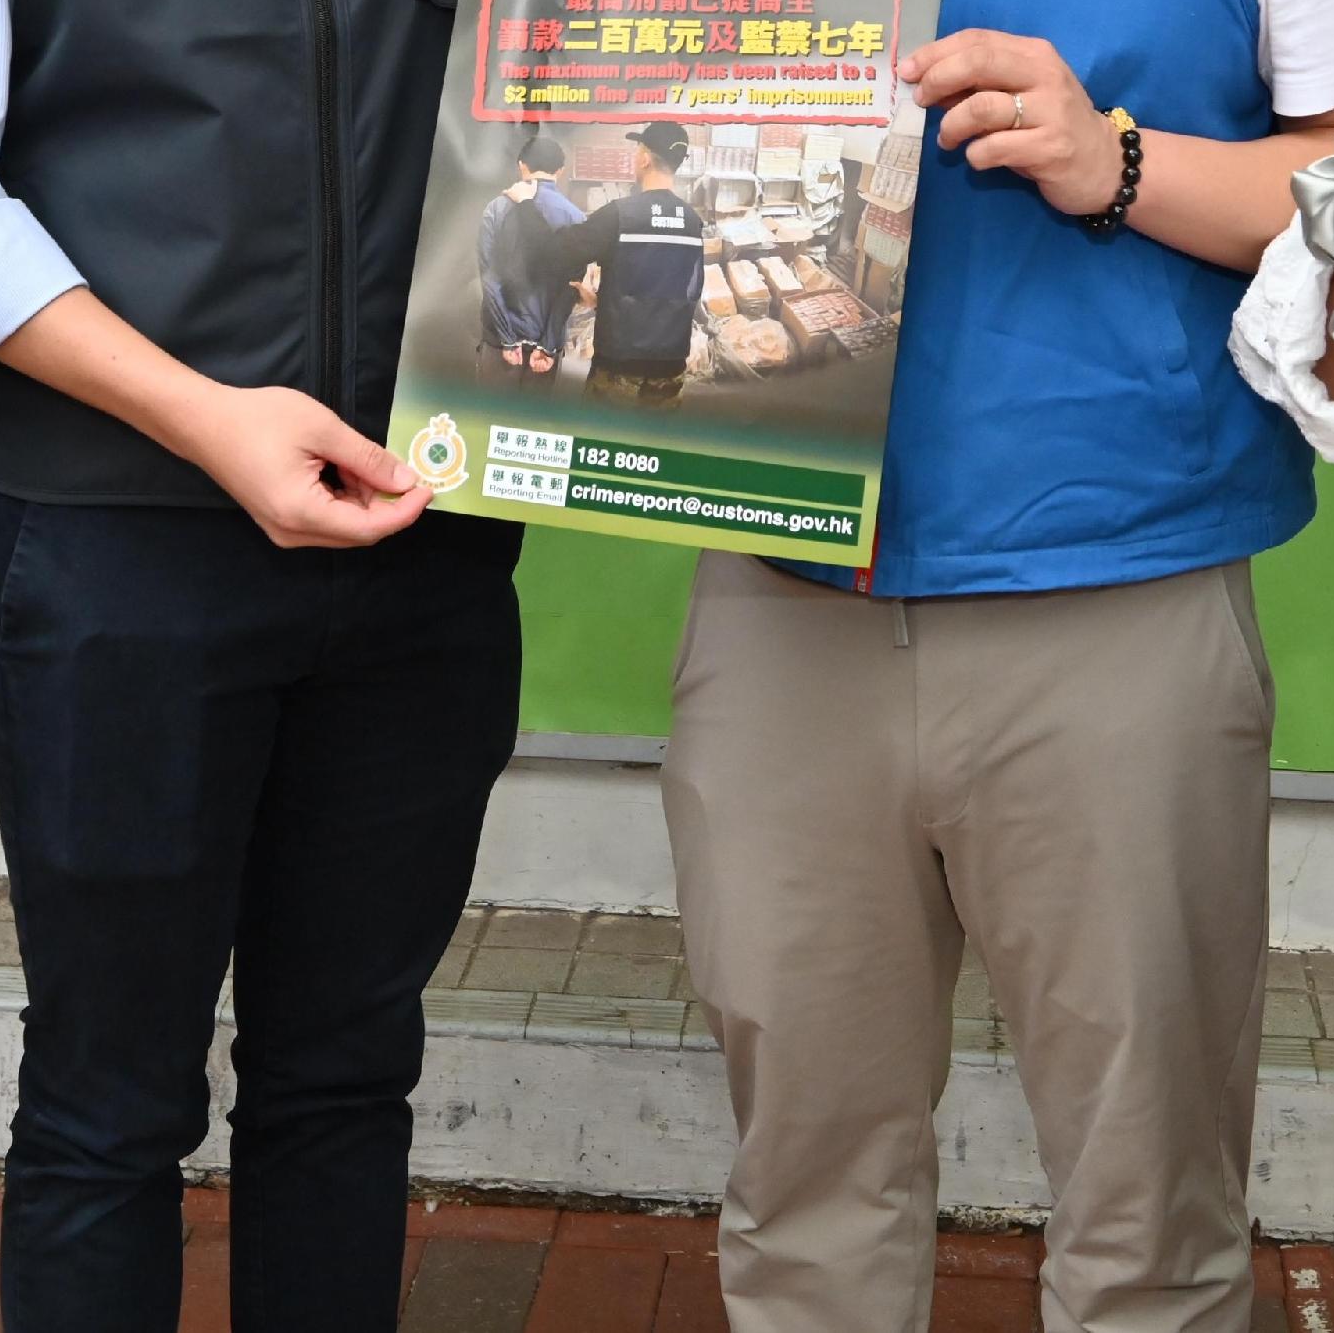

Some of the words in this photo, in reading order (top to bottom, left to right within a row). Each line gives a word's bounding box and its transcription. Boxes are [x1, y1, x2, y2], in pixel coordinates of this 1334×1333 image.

[497, 19, 884, 58] 罰款二百萬元及監禁七年
[499, 63, 531, 79] The
[534, 63, 620, 79] maximum
[625, 64, 689, 83] penalty
[695, 64, 727, 80] has
[733, 65, 777, 80] been
[780, 64, 835, 81] raised
[840, 65, 860, 81] to
[865, 68, 876, 81] a
[504, 86, 526, 104] $2
[530, 86, 590, 103] million
[595, 86, 629, 103] fine
[634, 86, 666, 103] and
[672, 86, 681, 103] 7
[689, 86, 742, 107] years'
[748, 87, 873, 108] imprisonment
[496, 431, 568, 453] 舉報熱線
[493, 446, 536, 462] Reporting
[538, 451, 568, 466] Hotline
[577, 446, 609, 467] 182
[614, 452, 659, 473] 8080
[492, 469, 564, 491] 舉報電郵
[488, 484, 534, 499] Reporting
[537, 490, 563, 502] Email
[571, 484, 853, 535] crimereport@customs.gov.hk
